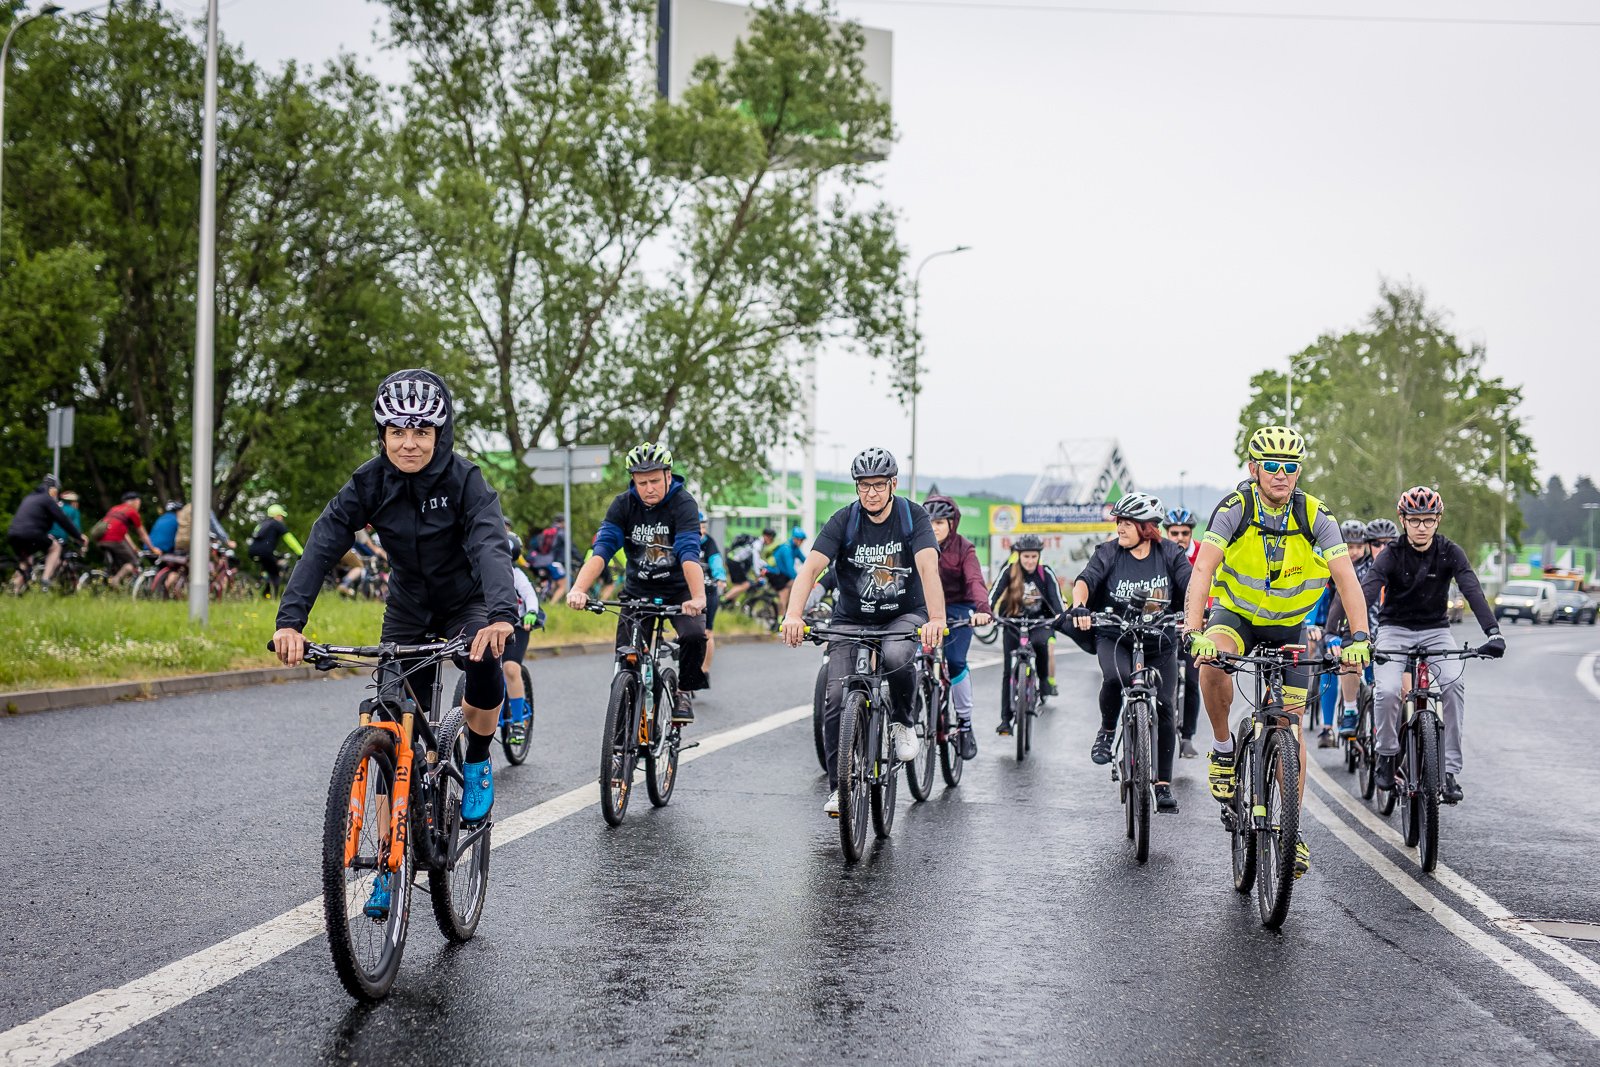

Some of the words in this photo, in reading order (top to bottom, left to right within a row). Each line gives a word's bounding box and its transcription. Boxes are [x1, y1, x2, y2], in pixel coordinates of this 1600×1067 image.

[854, 543, 884, 556] Jelenia
[885, 540, 902, 555] Góra
[854, 555, 864, 563] na
[865, 554, 888, 565] rowery
